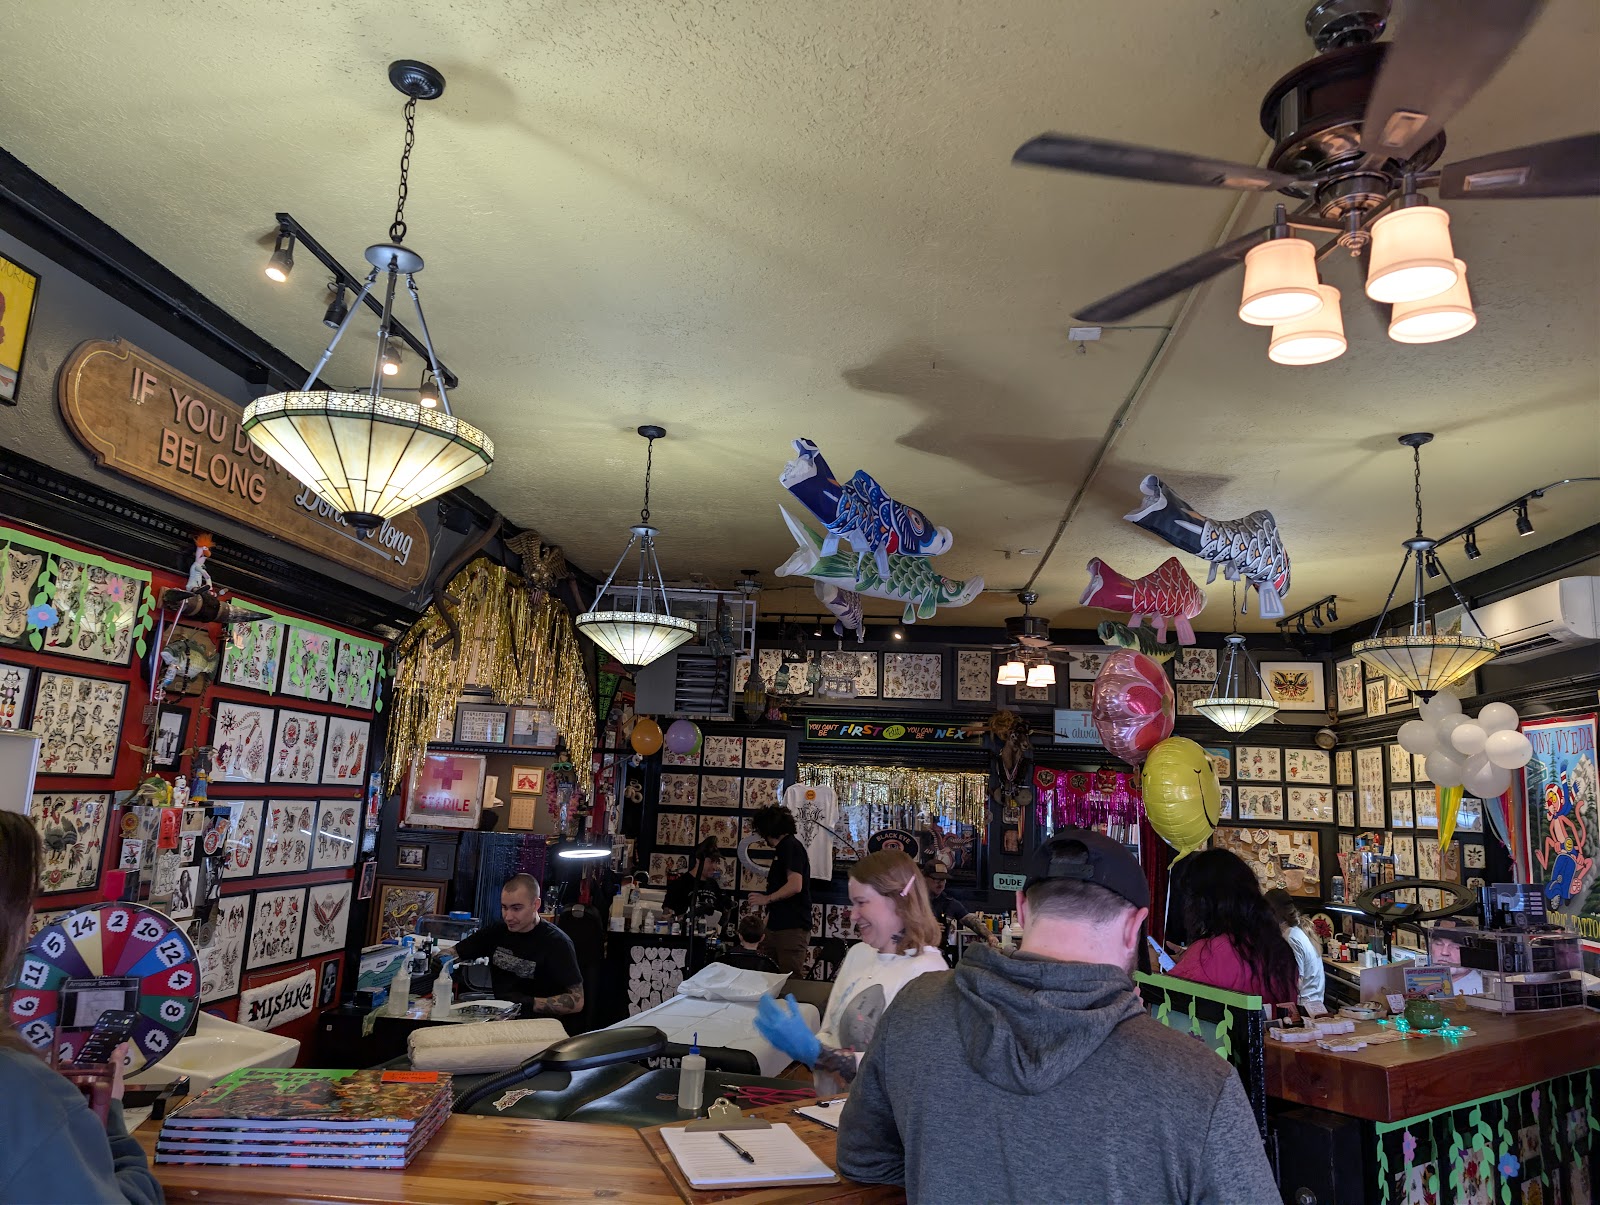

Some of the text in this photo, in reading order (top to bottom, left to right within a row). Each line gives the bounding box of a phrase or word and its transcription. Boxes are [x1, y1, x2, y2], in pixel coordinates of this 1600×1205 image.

[131, 367, 158, 404] IF
[170, 387, 228, 443] YOU
[158, 427, 267, 503] BELONG
[378, 518, 414, 567] long
[817, 729, 829, 737] BE
[839, 723, 883, 737] FIRST
[920, 726, 934, 734] CAN
[1555, 727, 1595, 755] VYEDA
[876, 832, 912, 845] BLACK EYE
[998, 877, 1023, 887] DUDE
[71, 915, 97, 938] 14
[111, 914, 124, 928] 2
[137, 922, 159, 938] 10
[46, 936, 61, 954] 5
[159, 942, 182, 964] 12
[24, 964, 45, 985] 11
[172, 973, 188, 987] 4
[165, 1004, 181, 1017] 8
[248, 978, 313, 1028] MISHKA
[26, 1023, 52, 1045] 13
[149, 1036, 163, 1048] 1
